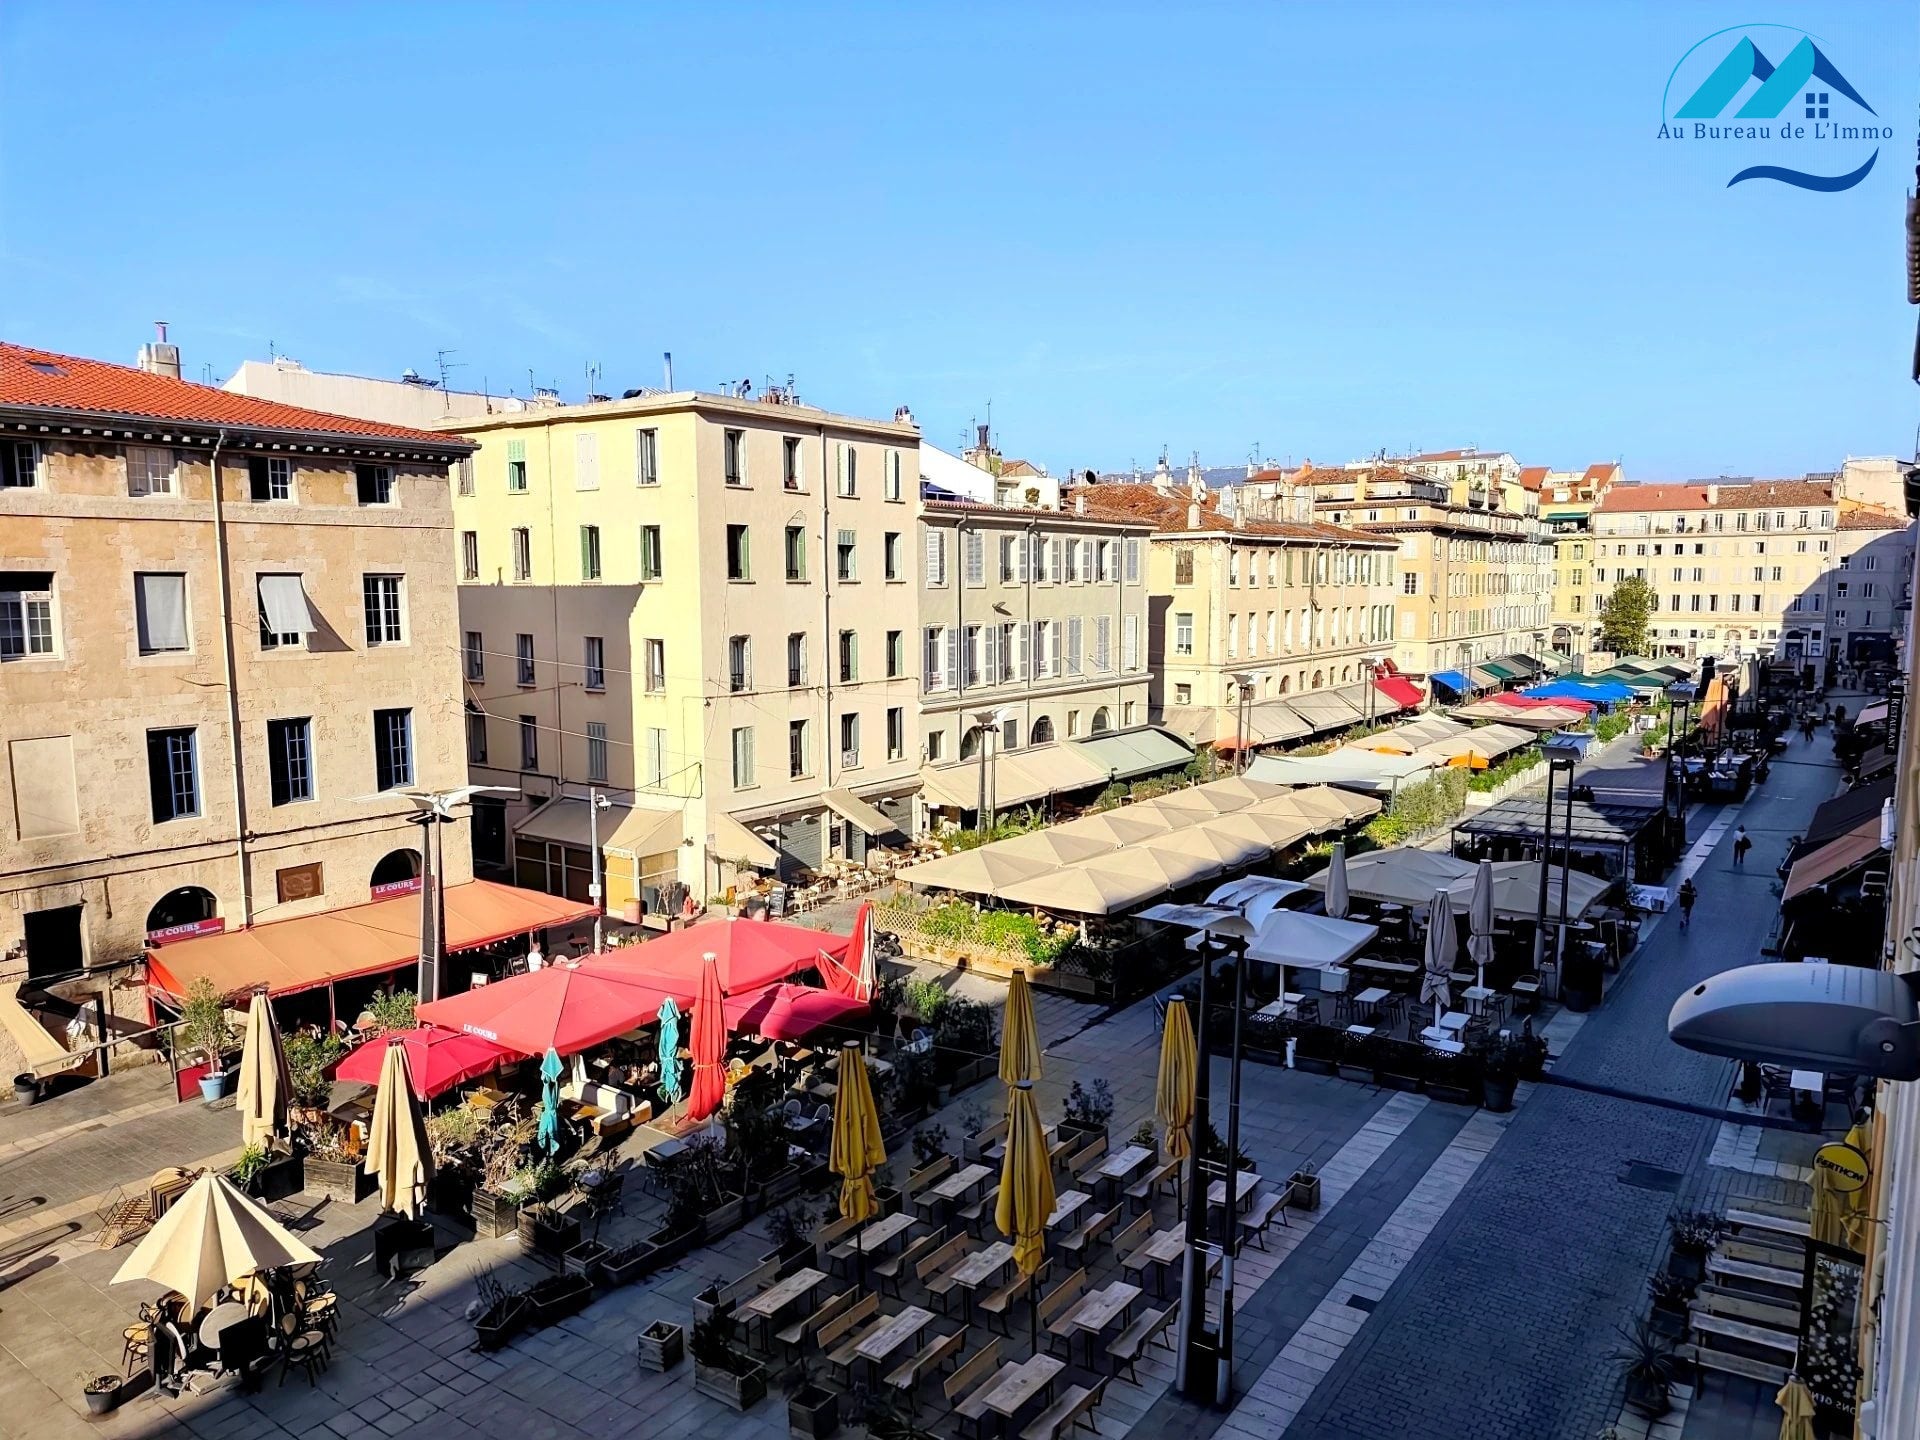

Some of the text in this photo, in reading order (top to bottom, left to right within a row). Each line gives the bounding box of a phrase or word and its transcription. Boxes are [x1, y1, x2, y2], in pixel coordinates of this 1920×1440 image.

[375, 886, 386, 894] LE
[386, 880, 414, 891] COURS
[151, 922, 200, 939] LE COURS
[472, 1026, 497, 1040] COURS
